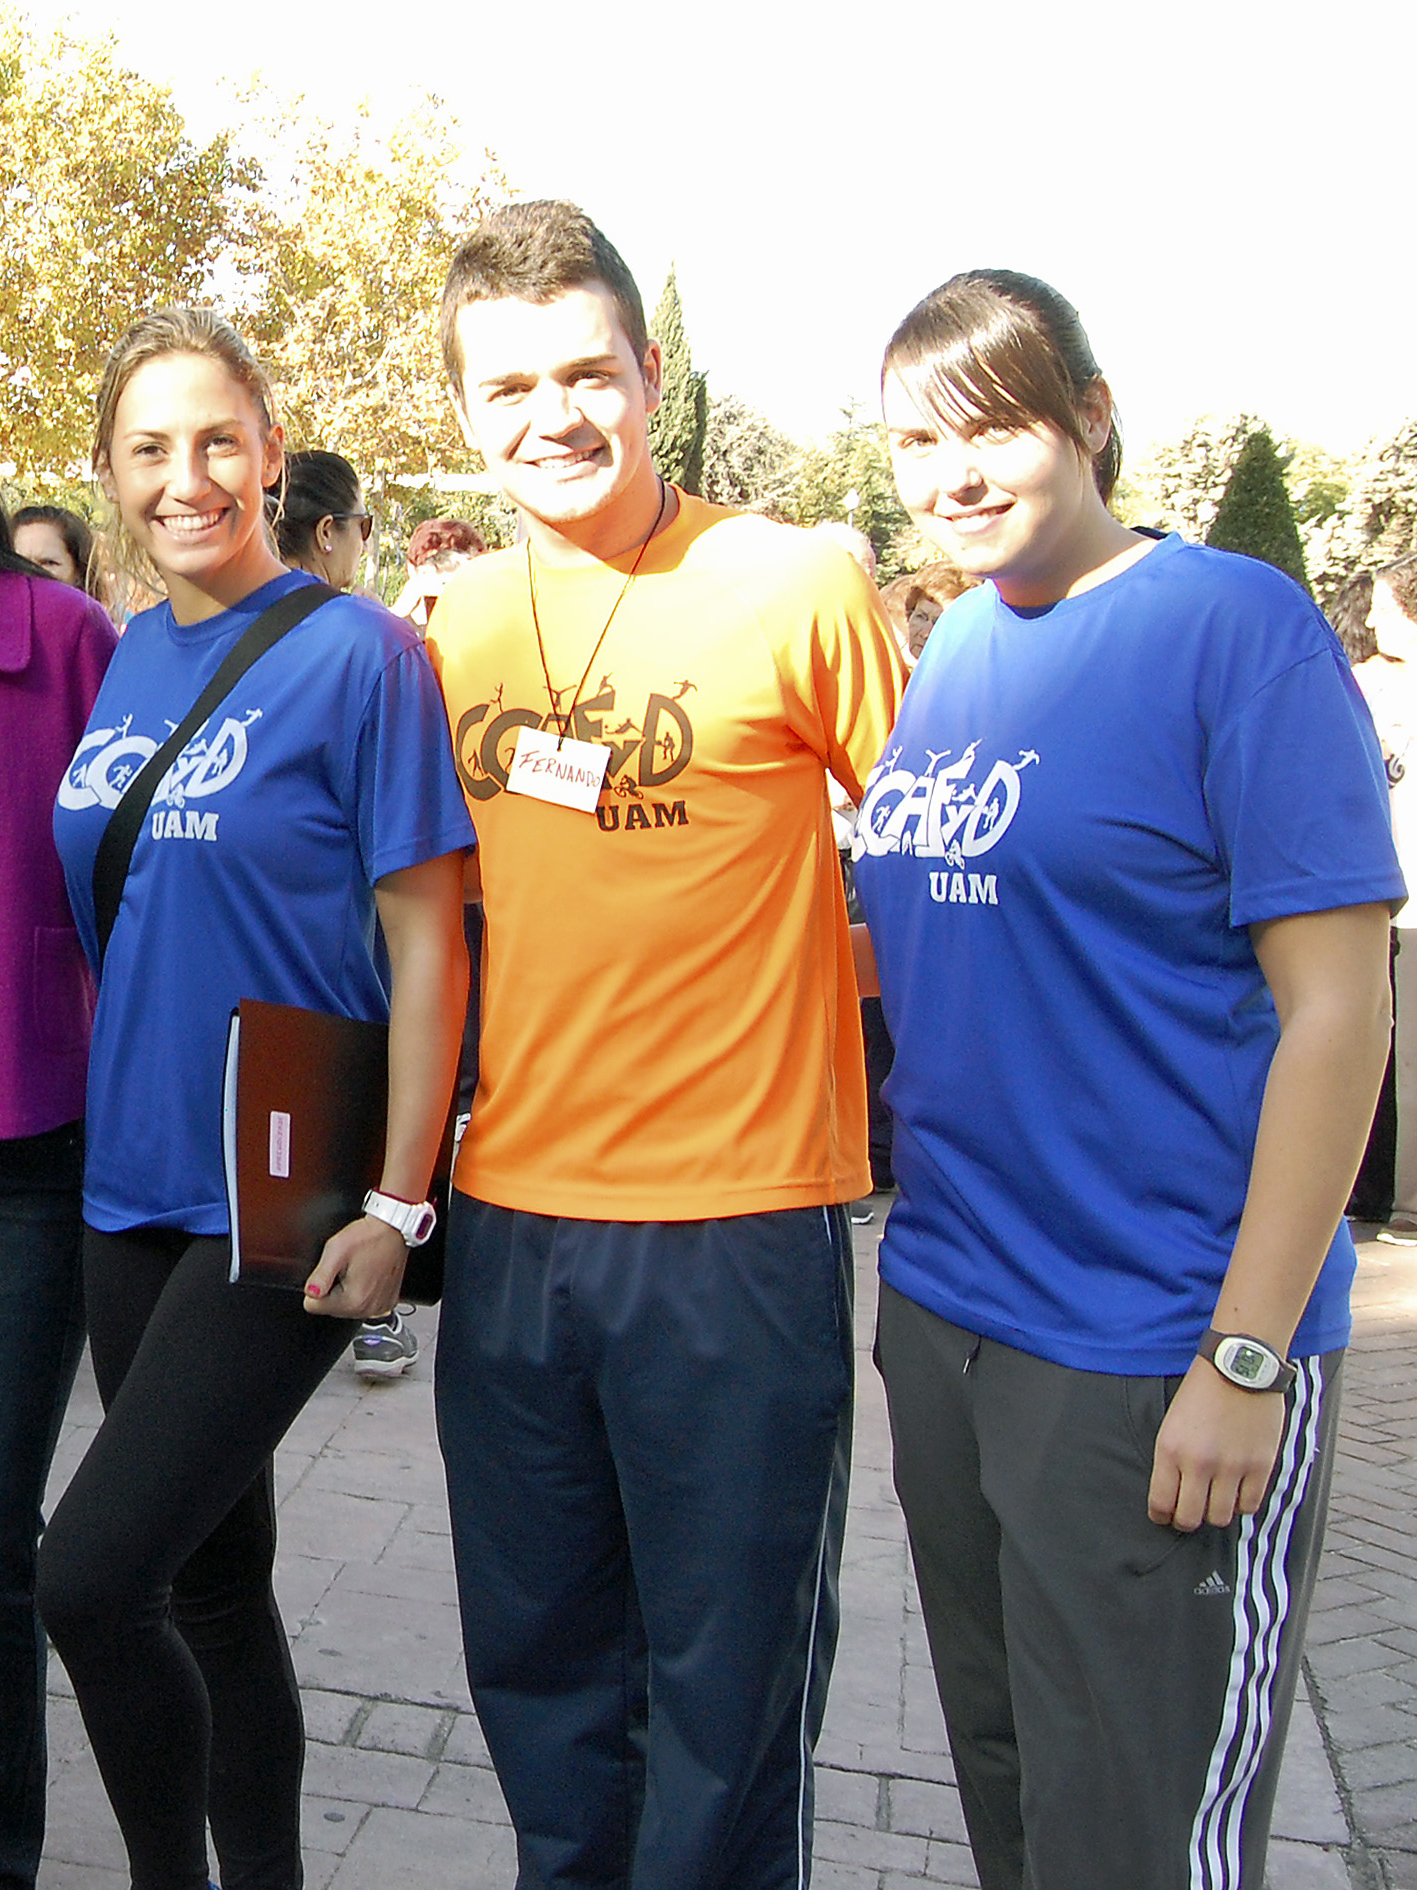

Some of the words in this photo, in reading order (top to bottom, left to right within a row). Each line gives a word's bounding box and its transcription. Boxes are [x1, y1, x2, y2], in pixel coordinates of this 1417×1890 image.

[519, 751, 601, 789] FERNANDO
[151, 810, 220, 842] UAM
[596, 800, 690, 832] UAM
[928, 871, 999, 905] UAM
